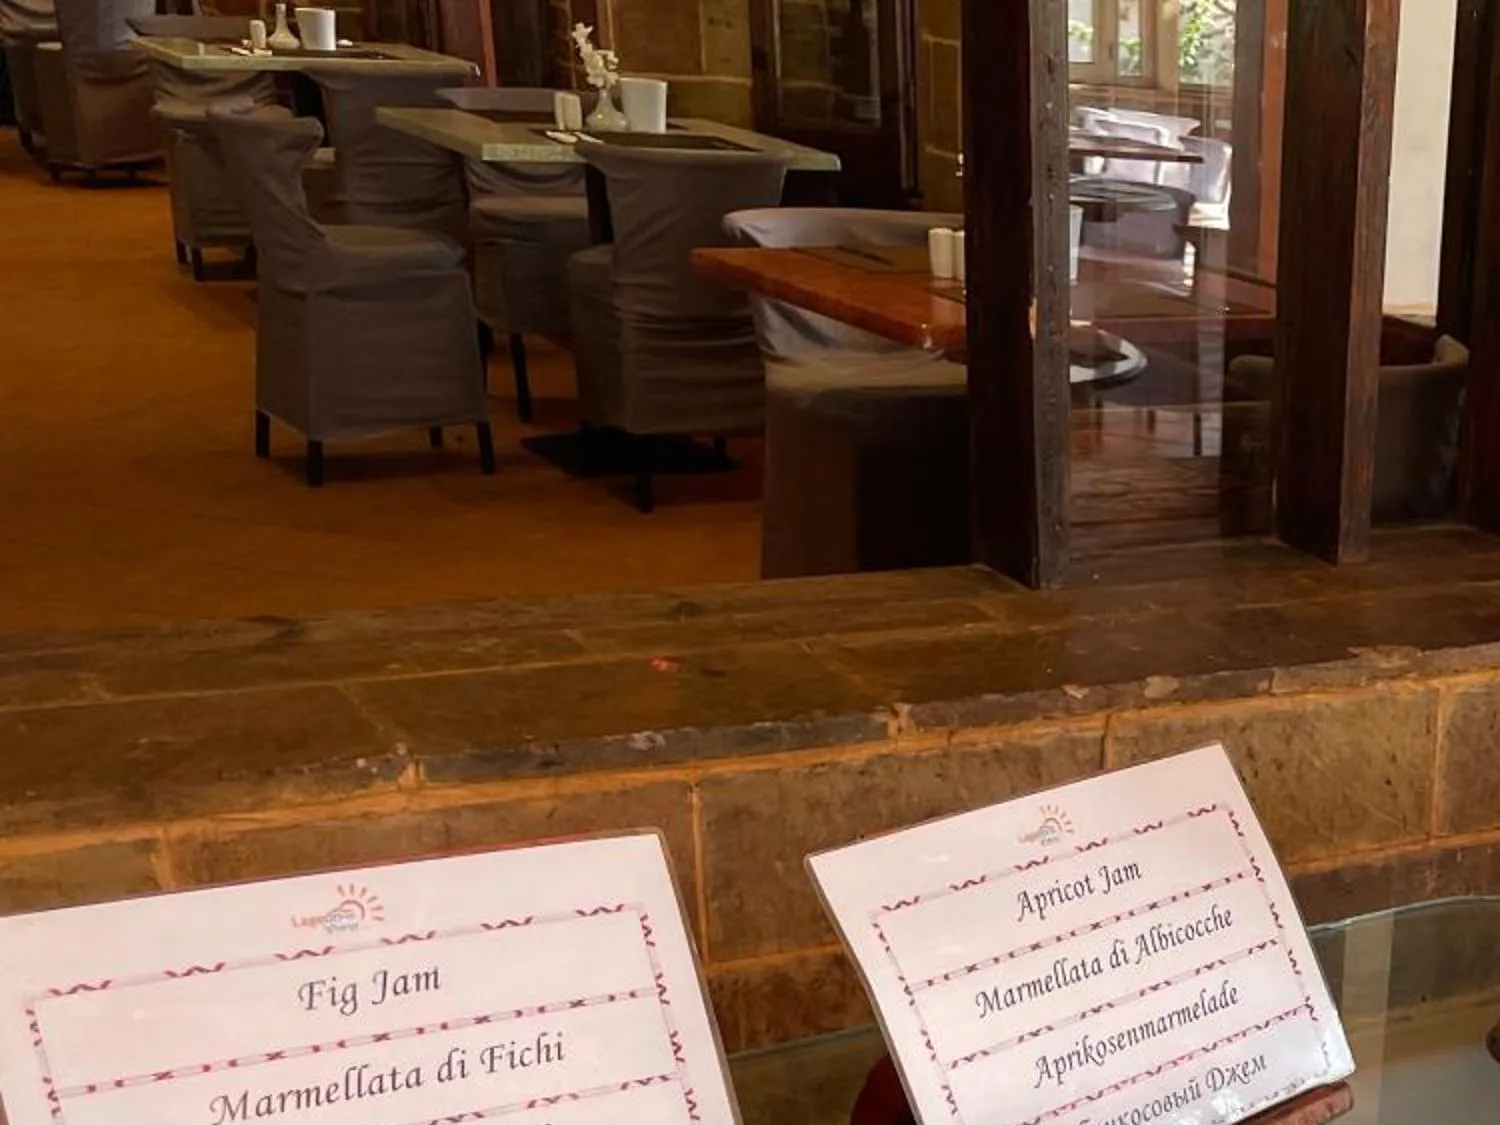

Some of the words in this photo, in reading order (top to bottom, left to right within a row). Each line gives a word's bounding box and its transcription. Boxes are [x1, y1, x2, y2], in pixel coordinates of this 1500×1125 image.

[1017, 874, 1095, 922] Apricot
[1098, 862, 1142, 895] Jam
[299, 976, 358, 1016] Fig
[371, 966, 441, 1005] Jam
[975, 957, 1103, 1019] Marmellata
[1109, 939, 1129, 969] di
[1134, 903, 1233, 965] Albicocche
[1034, 979, 1239, 1089] Aprikosenmarmelade
[209, 1063, 425, 1125] Marmellata
[436, 1047, 469, 1082] di
[479, 1031, 566, 1075] Fichi
[1205, 1054, 1267, 1092] Джем
